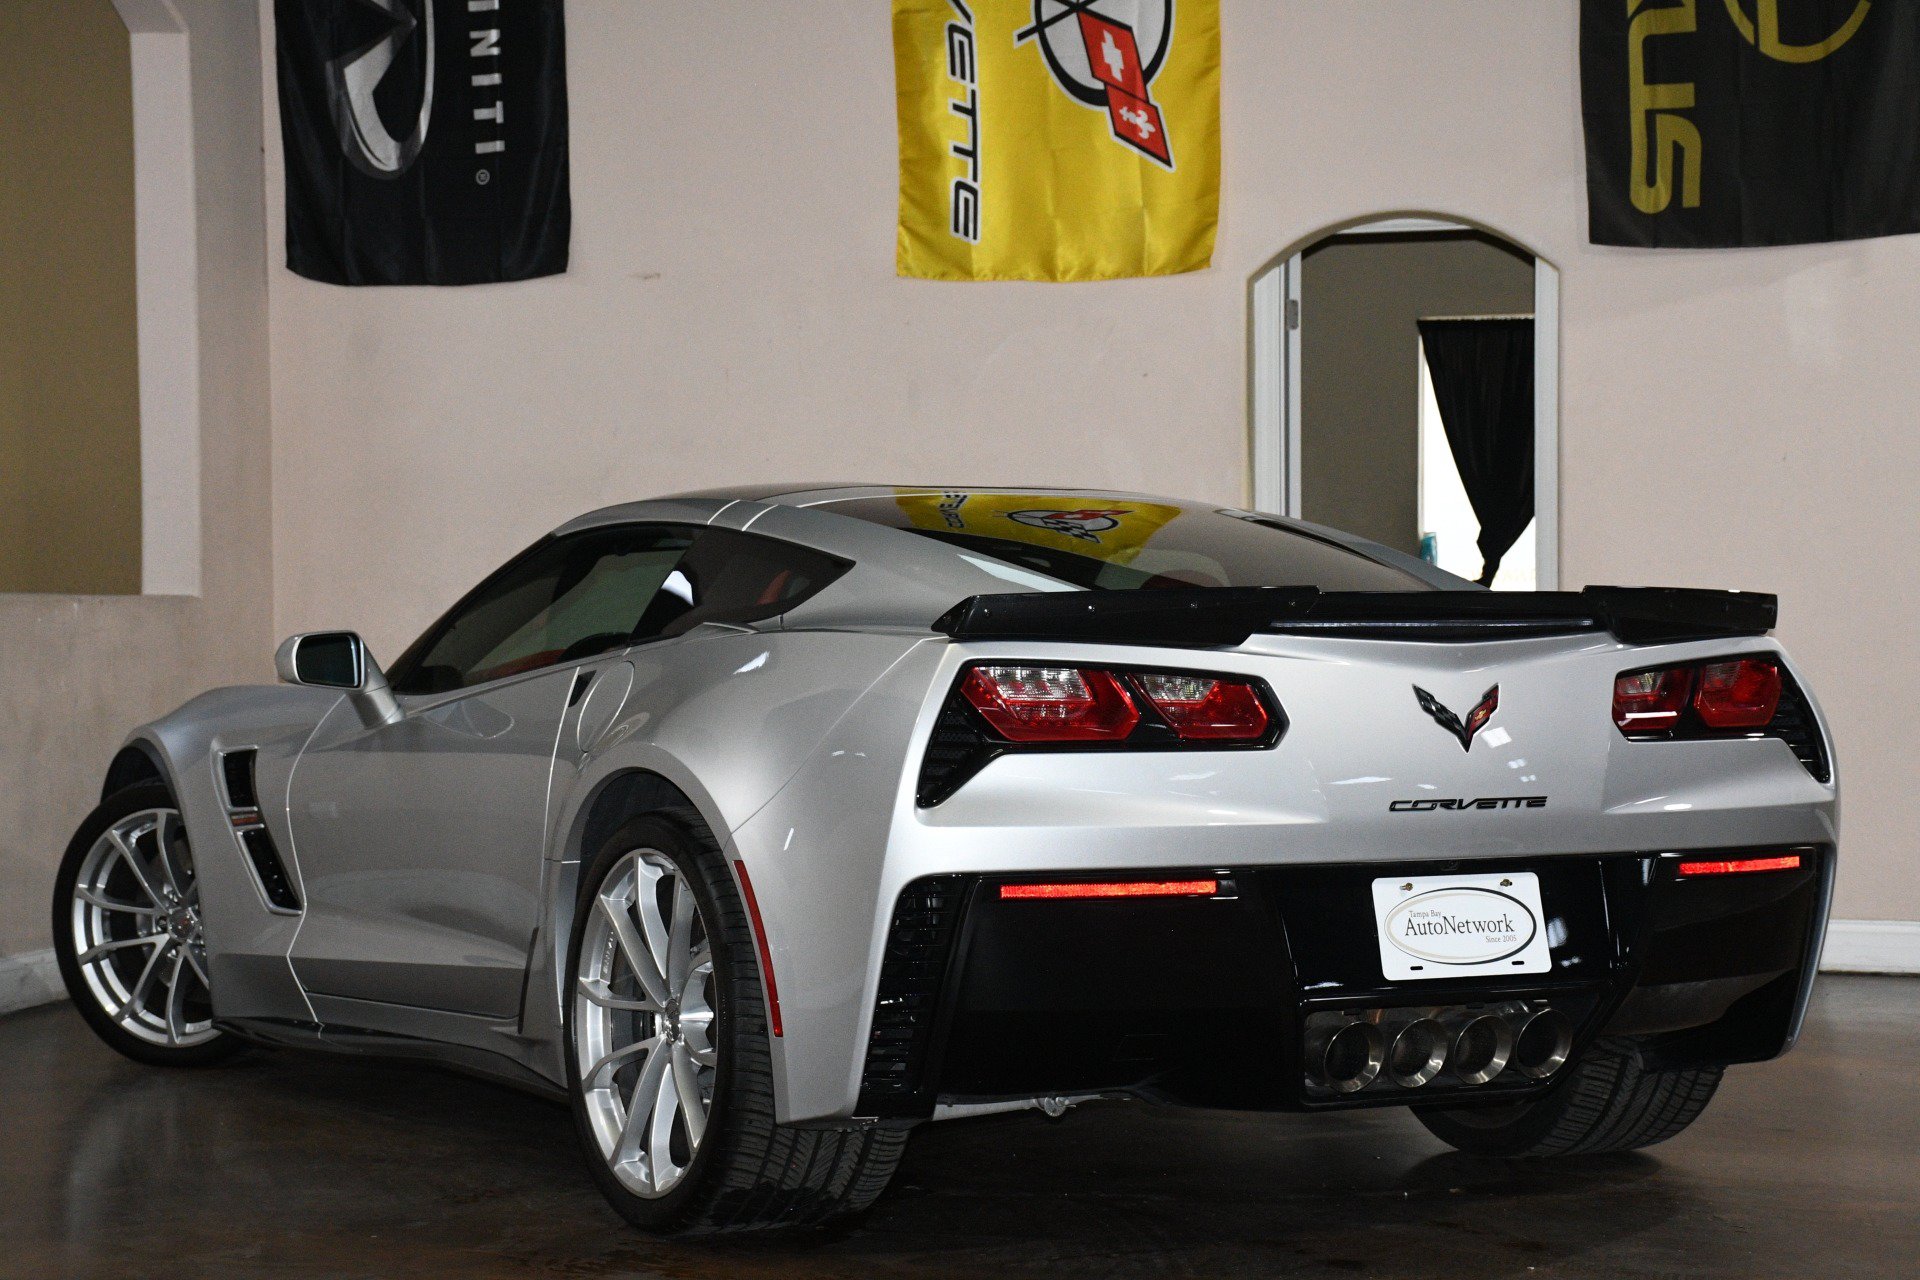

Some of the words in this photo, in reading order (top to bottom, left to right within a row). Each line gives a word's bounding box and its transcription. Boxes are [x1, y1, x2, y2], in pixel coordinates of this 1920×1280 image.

[1627, 0, 1702, 214] US
[1388, 795, 1549, 812] CORVETTE
[1409, 910, 1430, 919] Tampa
[1430, 909, 1442, 919] Bay
[1404, 913, 1515, 937] AutoNetwork
[1485, 935, 1501, 943] Since
[1502, 935, 1517, 943] 2005
